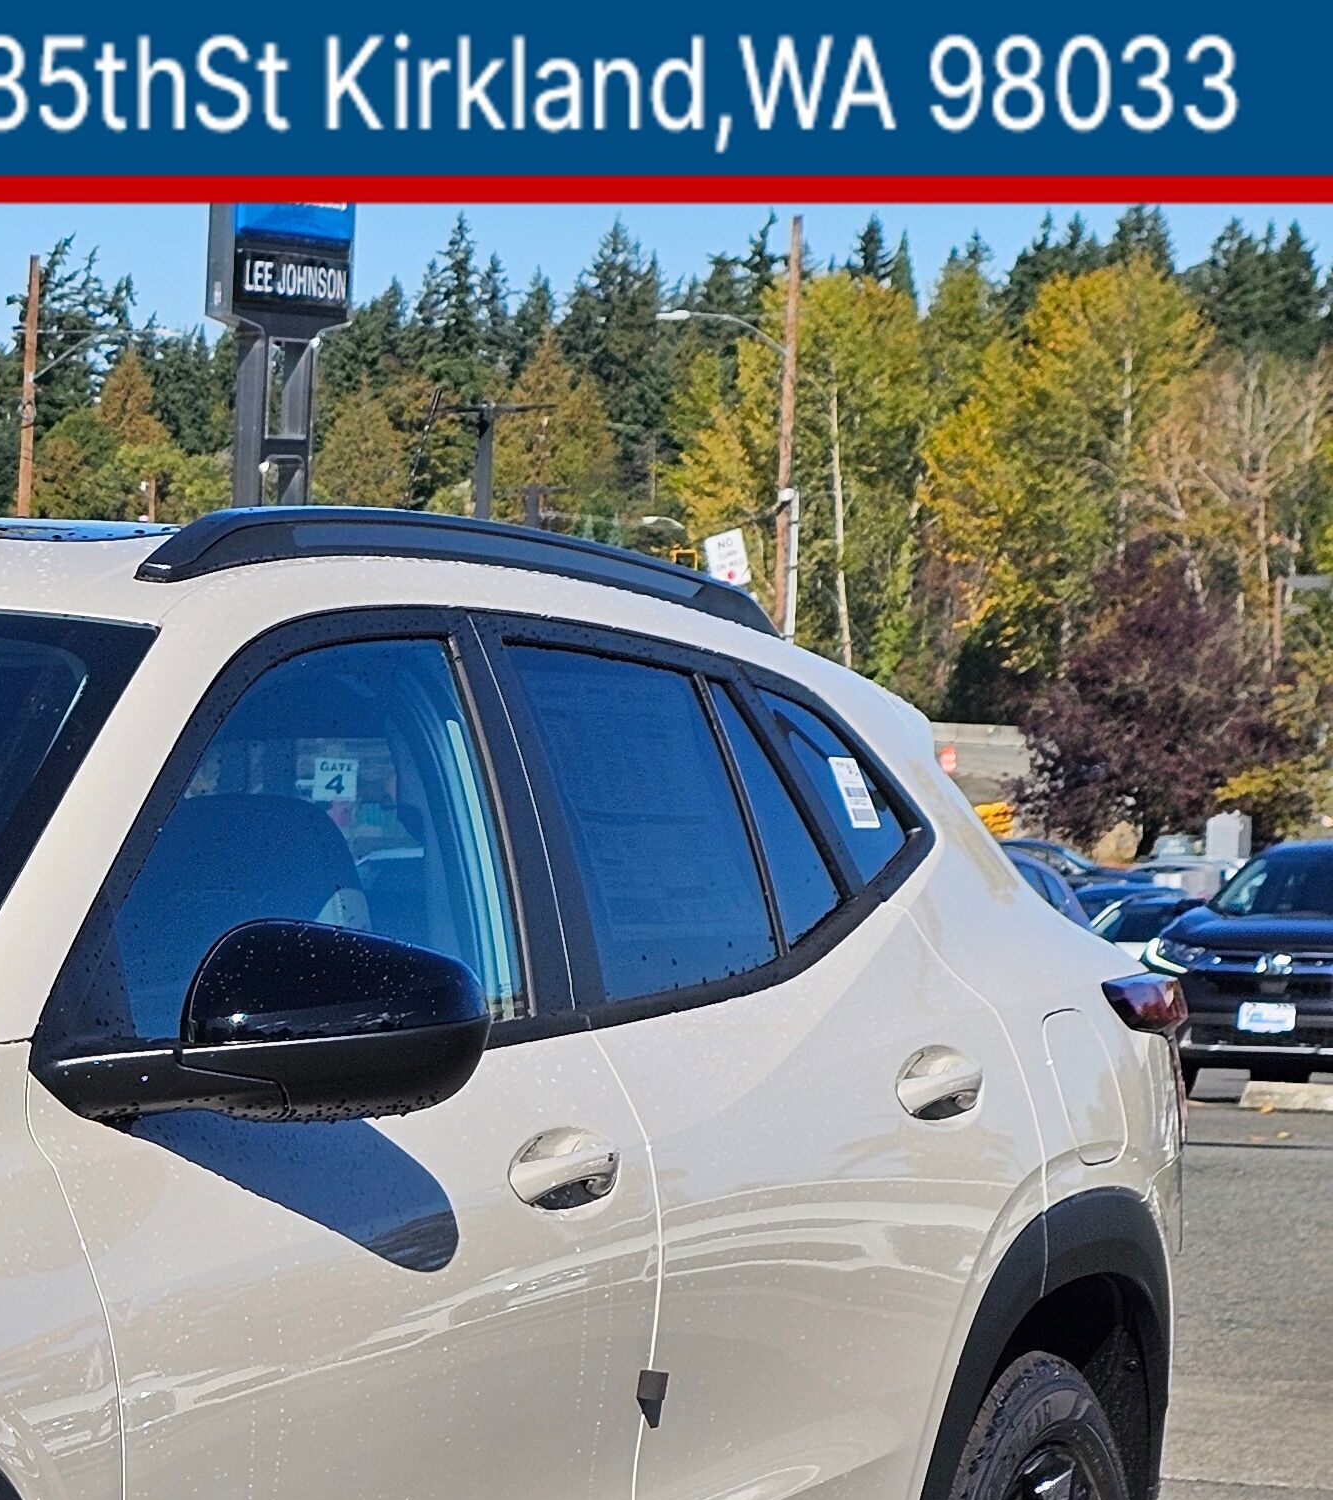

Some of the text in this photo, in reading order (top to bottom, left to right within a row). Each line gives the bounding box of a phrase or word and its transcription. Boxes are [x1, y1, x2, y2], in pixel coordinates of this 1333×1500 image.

[244, 258, 274, 293] LEE
[276, 264, 347, 301] JOHNSON
[324, 774, 346, 795] 4
